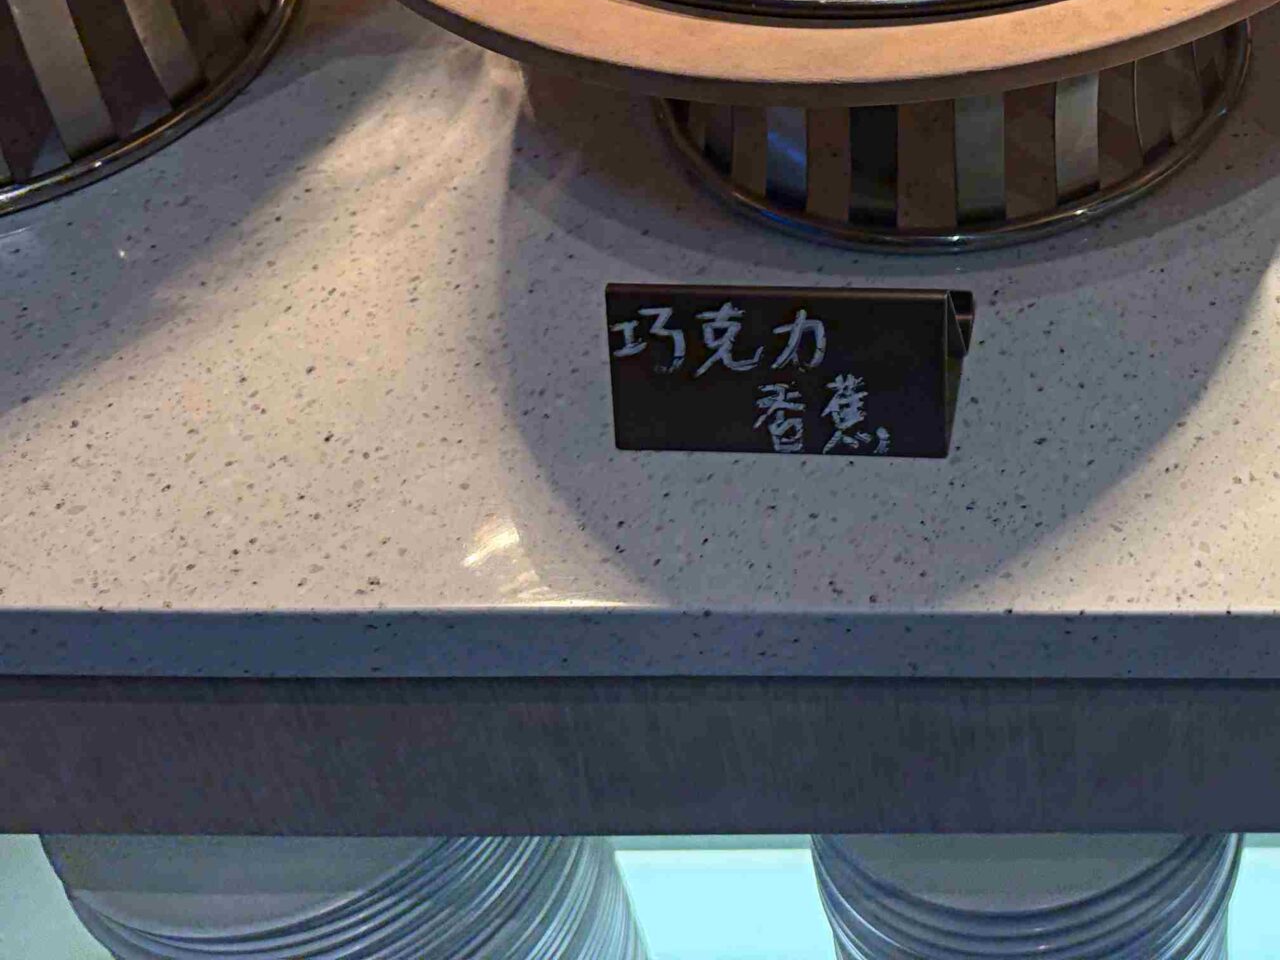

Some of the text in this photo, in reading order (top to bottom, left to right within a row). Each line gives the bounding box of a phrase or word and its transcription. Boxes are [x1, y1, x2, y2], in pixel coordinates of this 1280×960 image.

[611, 301, 827, 377] 巧克力
[753, 373, 891, 455] 香蕉
